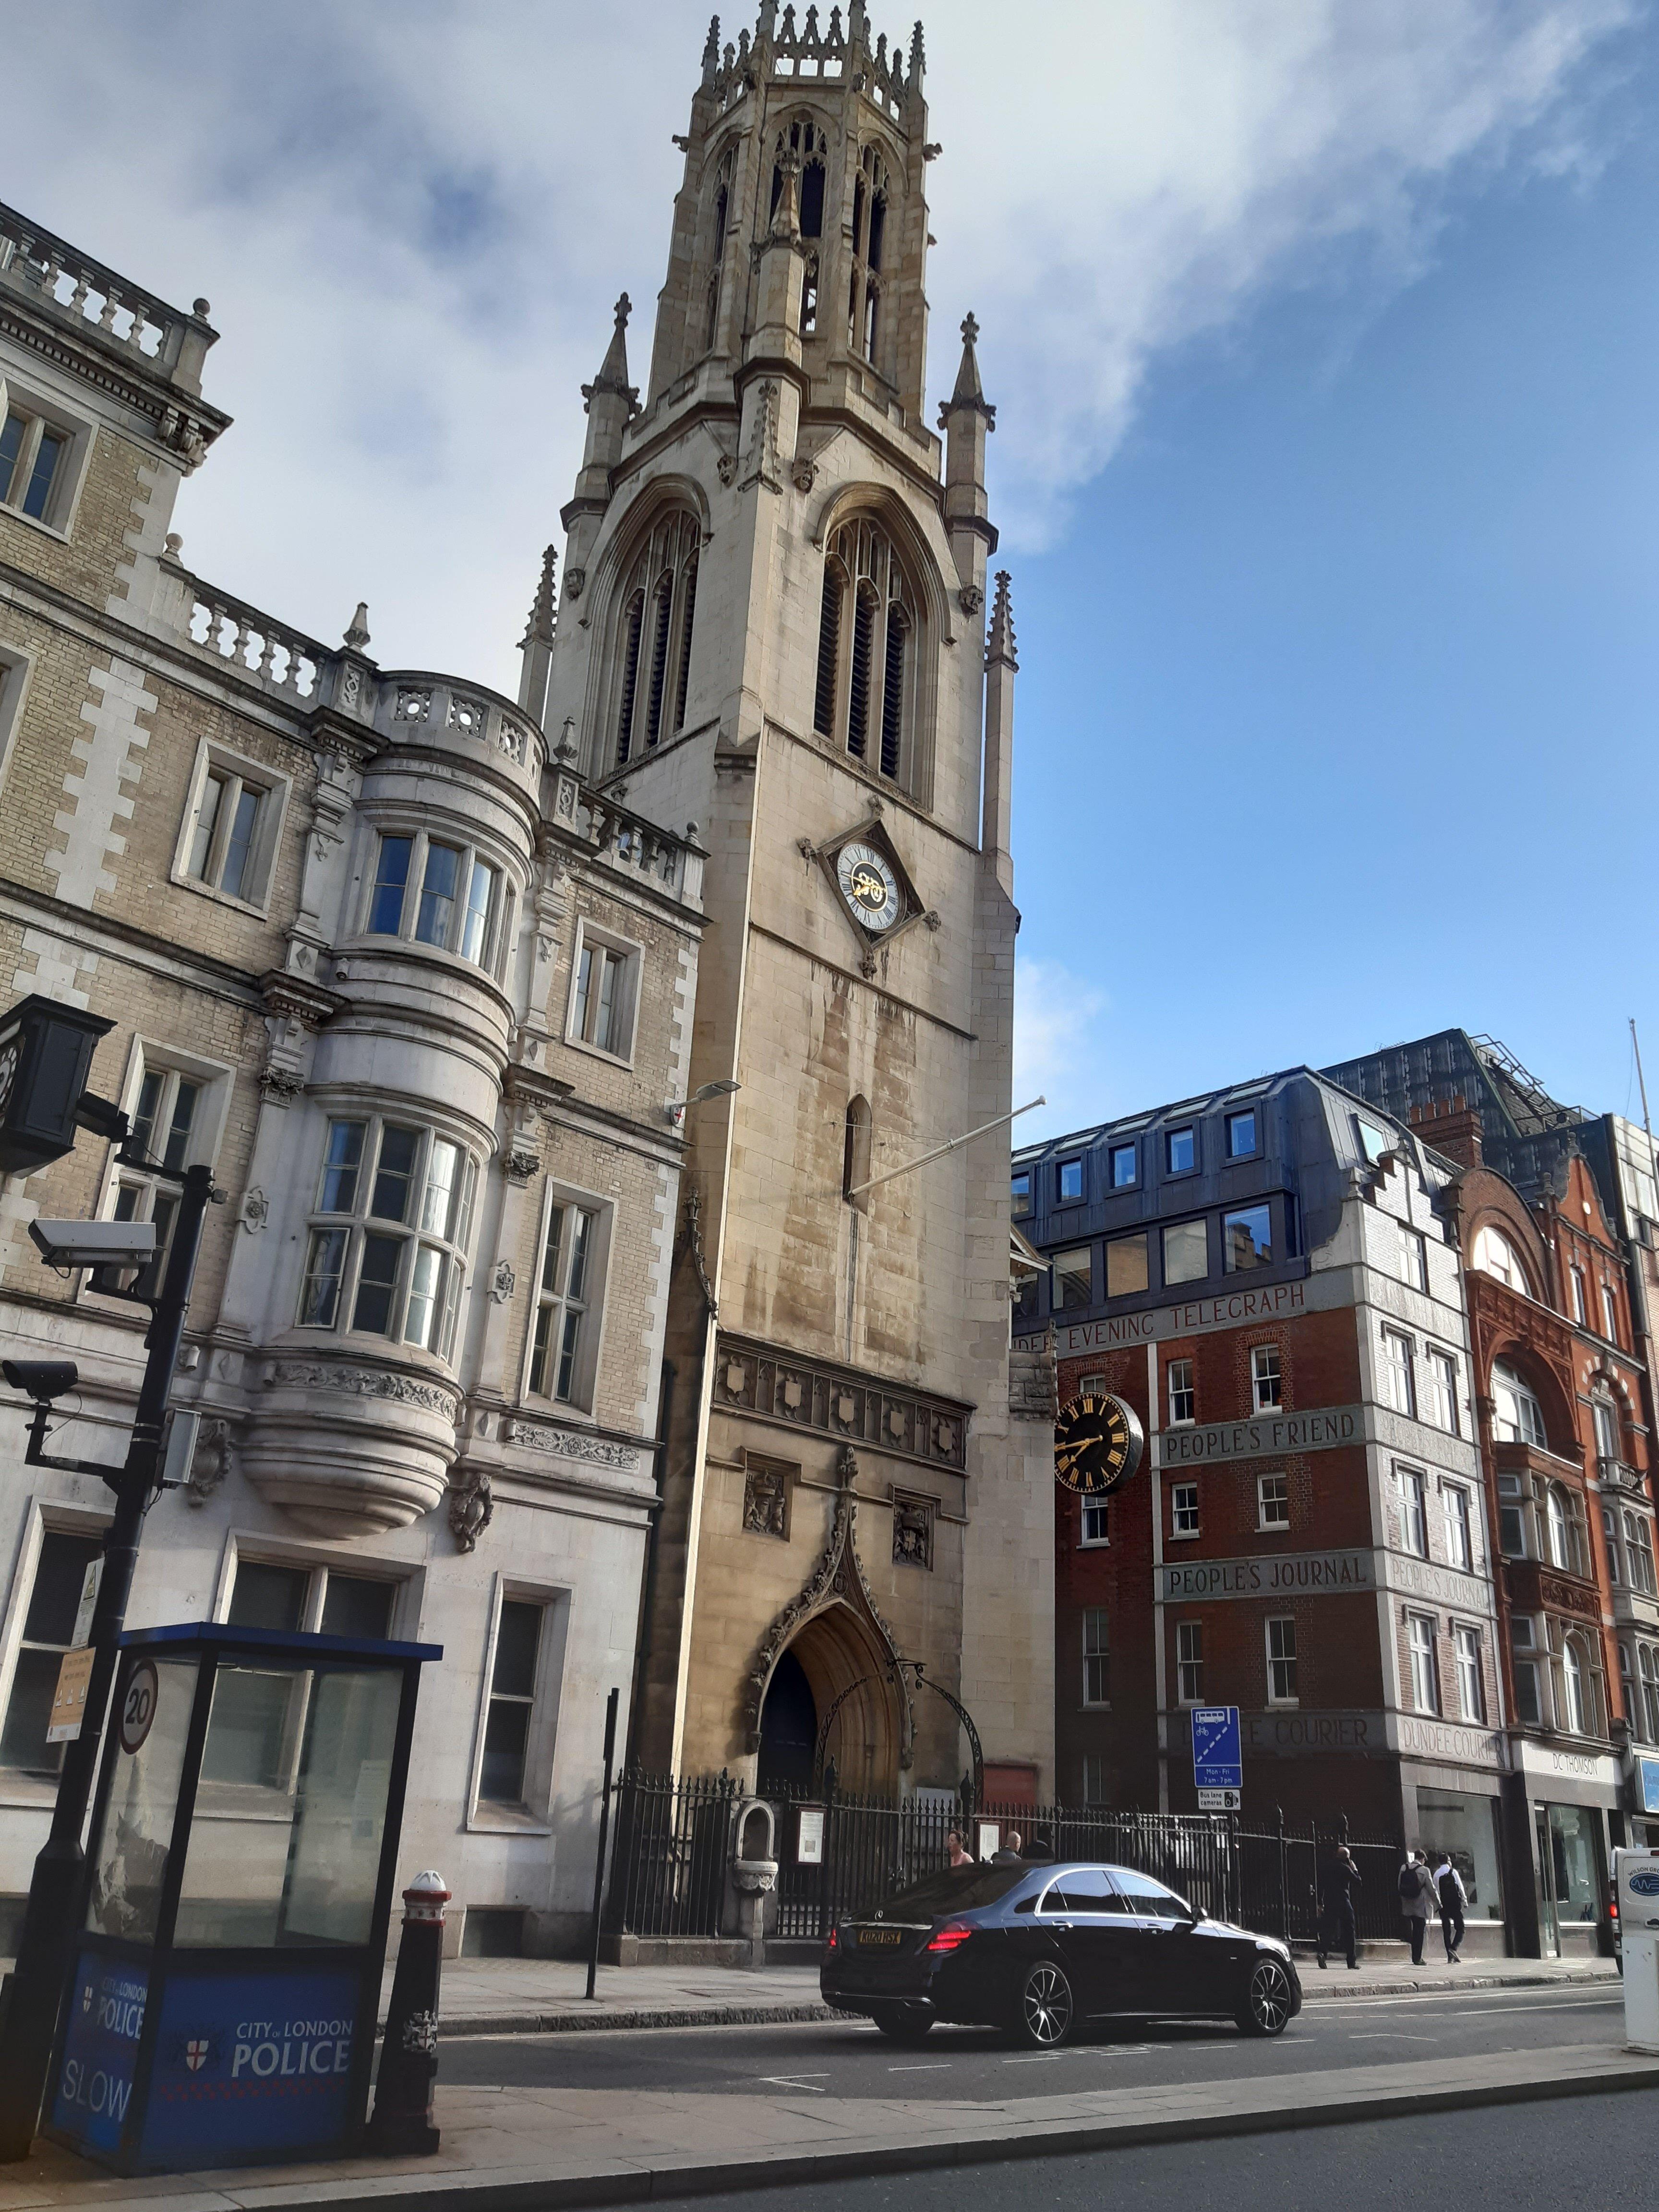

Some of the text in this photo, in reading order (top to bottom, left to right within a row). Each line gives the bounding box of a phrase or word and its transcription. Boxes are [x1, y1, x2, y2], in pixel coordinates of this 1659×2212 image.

[1069, 1314, 1154, 1349] EVENING
[1170, 1284, 1305, 1329] TELEGRAPH
[1167, 1425, 1261, 1460] PEOPLE'S
[1273, 1414, 1354, 1447] FRIEND
[1170, 1557, 1367, 1595] PEOPLE'S JOURNAL
[1393, 1559, 1489, 1609] PEOPLE'S JOURNAL
[125, 1688, 150, 1724] 20
[1275, 1719, 1369, 1745] COURIER
[1403, 1719, 1504, 1762] DUNDEE COURIER
[1552, 1753, 1598, 1776] DC THOMSON
[1628, 1867, 1648, 1876] WILSON
[119, 1982, 148, 2003] LONDON
[97, 1996, 144, 2040] POLICE
[236, 2022, 273, 2039] CITY
[284, 2020, 353, 2037] LONDON
[231, 2040, 351, 2078] POLICE
[63, 2059, 133, 2123] SLOW
